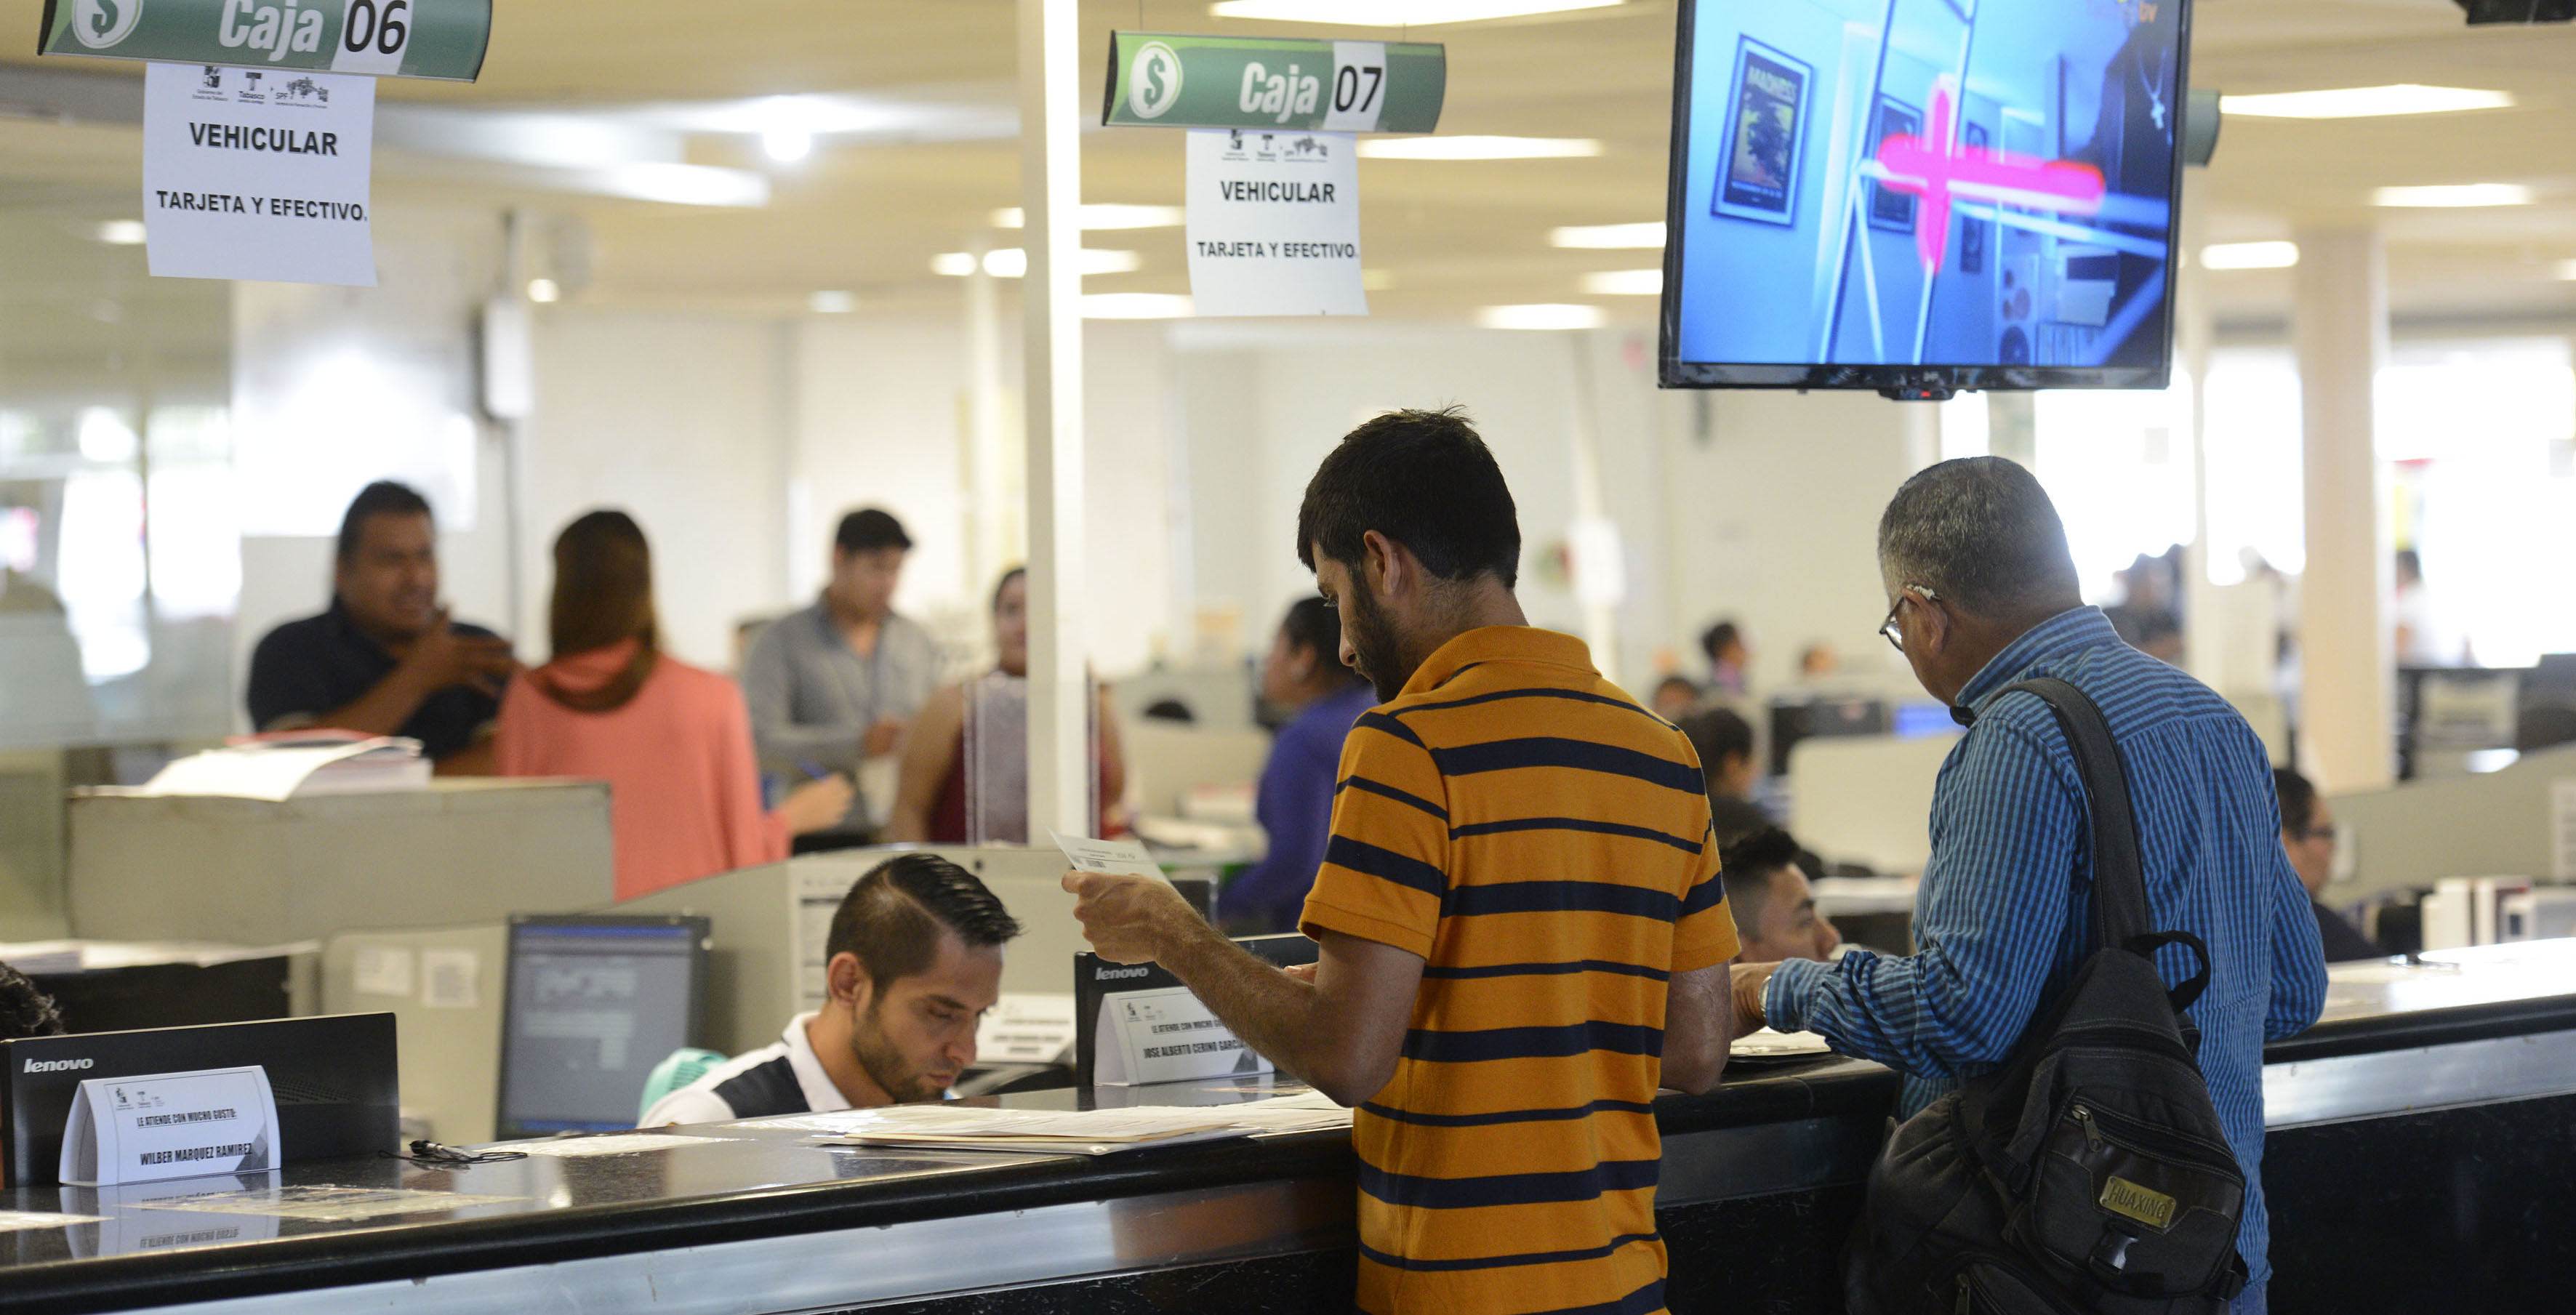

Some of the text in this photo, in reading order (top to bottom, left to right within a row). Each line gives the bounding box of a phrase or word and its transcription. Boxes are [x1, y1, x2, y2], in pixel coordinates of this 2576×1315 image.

[219, 0, 324, 62] Caja
[344, 0, 409, 55] 06
[1239, 61, 1319, 124] Caja
[1335, 65, 1382, 113] 07
[189, 122, 337, 156] VEHICULAR
[1220, 181, 1335, 203] VEHICULAR
[156, 190, 368, 221] TARJETA Y EFECTIVO.
[1197, 241, 1265, 257] TARJETA
[1268, 242, 1278, 257] Y
[1096, 967, 1148, 981] lenovo
[1161, 1044, 1191, 1057] ALBERTO
[23, 1058, 94, 1074] lenovo
[137, 1117, 145, 1127] LE
[145, 1114, 172, 1125] ATIENDE
[172, 1113, 187, 1124] CON
[188, 1111, 212, 1122] MUCHO
[140, 1142, 252, 1165] WILBER MARQUEZ RAMIREZ
[2108, 1183, 2167, 1219] HUAXING
